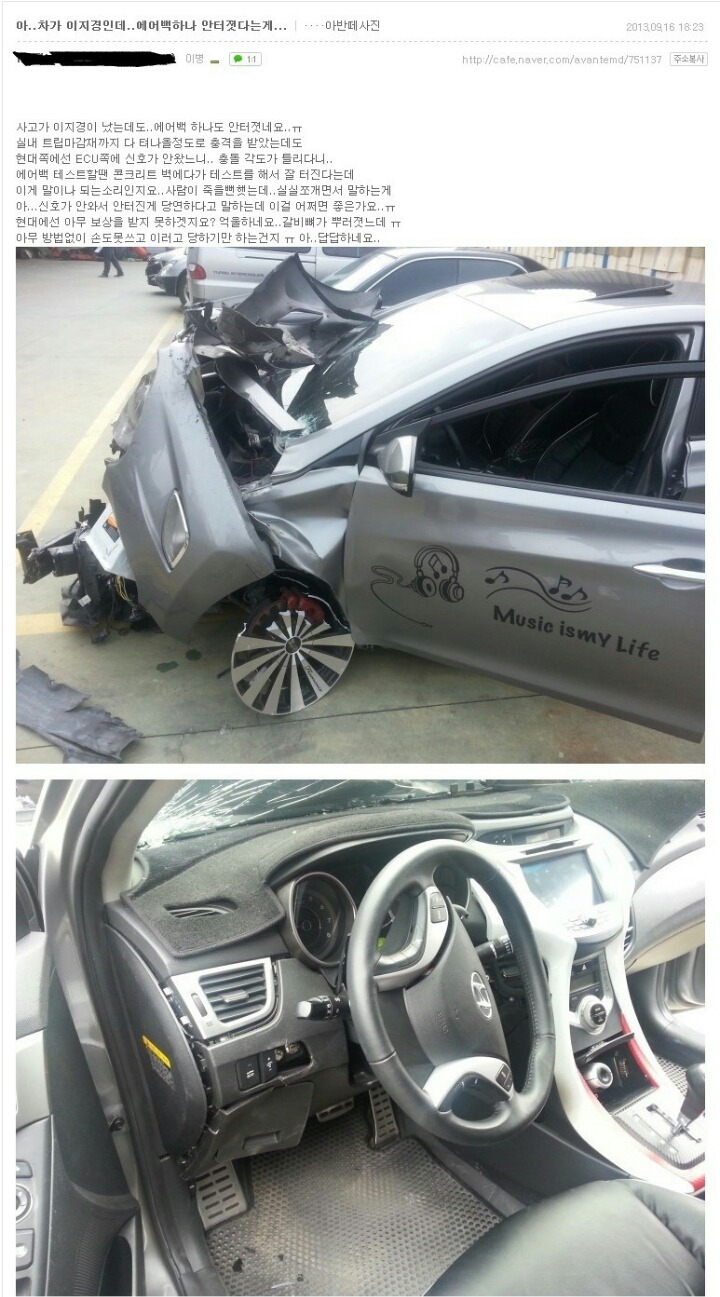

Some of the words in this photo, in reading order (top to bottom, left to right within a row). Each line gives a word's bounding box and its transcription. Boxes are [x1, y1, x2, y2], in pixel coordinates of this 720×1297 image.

[16, 19, 62, 31] 아..차가
[66, 19, 197, 31] 이지경인데..에어백하나
[679, 22, 704, 32] 18:23
[185, 53, 204, 64] 이병
[463, 54, 662, 66] http://cafe.naver.com/avantemd/751137
[673, 54, 705, 64] 주소복사
[16, 121, 49, 132] 사고가
[53, 121, 96, 132] 이지경이
[101, 121, 185, 132] 났는데도..에어백
[190, 121, 223, 132] 하나도
[16, 137, 36, 148] 실내
[124, 137, 135, 148] 다
[210, 137, 242, 148] 충격을
[247, 137, 302, 148] 받았는데도
[15, 153, 70, 164] 현대쪽에선
[75, 153, 119, 164] ECU쪽에
[125, 153, 158, 164] 신호가
[162, 153, 212, 164] 안왔느니..
[218, 153, 239, 164] 충돌
[244, 153, 277, 164] 각도가
[281, 153, 332, 164] 틀리다니..
[16, 168, 48, 180] 에어백
[53, 168, 107, 180] 테스트할땐
[113, 168, 157, 180] 콘크리트
[161, 168, 206, 180] 벽에다가
[209, 168, 253, 180] 테스트를
[257, 168, 279, 180] 해서
[284, 168, 295, 180] 잘
[299, 168, 353, 180] 터진다는데
[16, 184, 36, 196] 이게
[42, 184, 76, 196] 말이나
[79, 184, 197, 196] 되는소리인지요..사람이
[347, 184, 390, 196] 말하는게
[16, 200, 72, 212] 아...신호가
[75, 200, 107, 212] 안와서
[113, 200, 156, 212] 안터진게
[161, 200, 216, 212] 당연하다고
[221, 200, 264, 212] 말하는데
[269, 200, 290, 212] 이걸
[295, 200, 327, 212] 어쩌면
[15, 216, 59, 227] 현대에선
[64, 216, 85, 227] 아무
[90, 216, 123, 227] 보상을
[127, 216, 148, 227] 받지
[219, 216, 327, 227] 억울하네요..갈비뼈가
[16, 232, 37, 243] 아무
[42, 232, 85, 243] 방법없이
[90, 232, 145, 243] 손도못쓰고
[150, 232, 183, 243] 이러고
[187, 232, 232, 243] 당하기만
[235, 232, 279, 243] 하는건지
[299, 232, 379, 243] 아..답답하네요..
[493, 605, 553, 633] Music
[616, 636, 660, 661] Life
